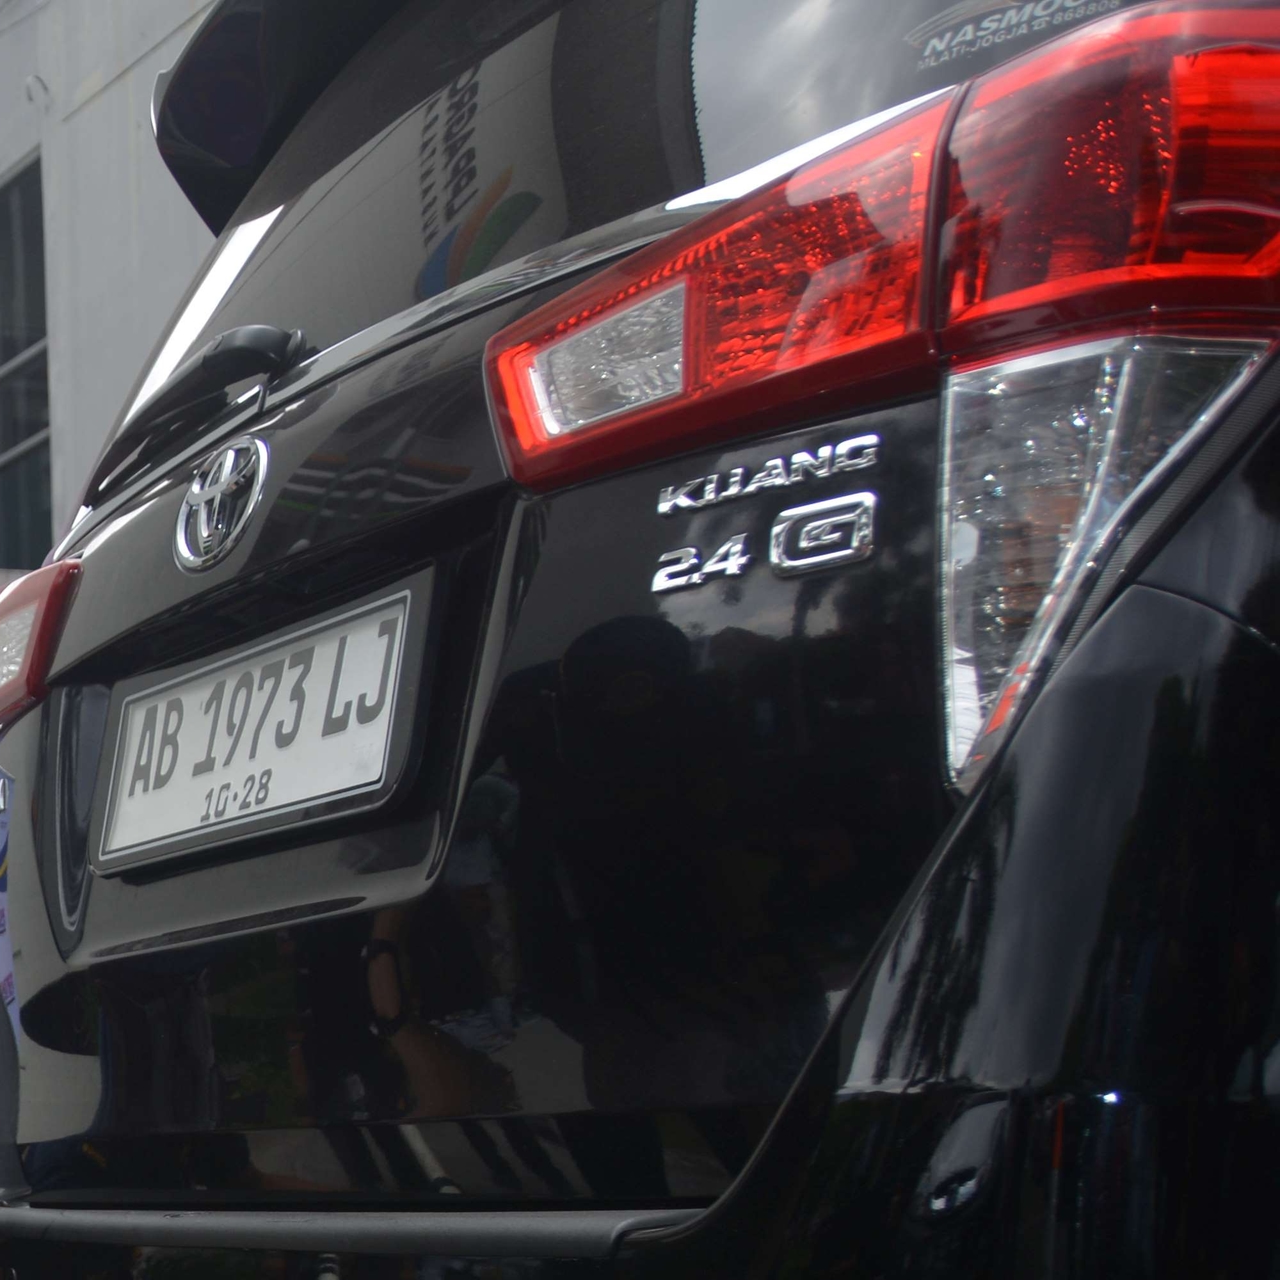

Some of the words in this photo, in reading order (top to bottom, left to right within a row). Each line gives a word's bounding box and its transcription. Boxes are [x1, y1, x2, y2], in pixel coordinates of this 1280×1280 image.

[657, 434, 880, 514] KIJANG
[128, 697, 184, 798] AB
[192, 645, 316, 778] 1973
[321, 616, 400, 740] LJ
